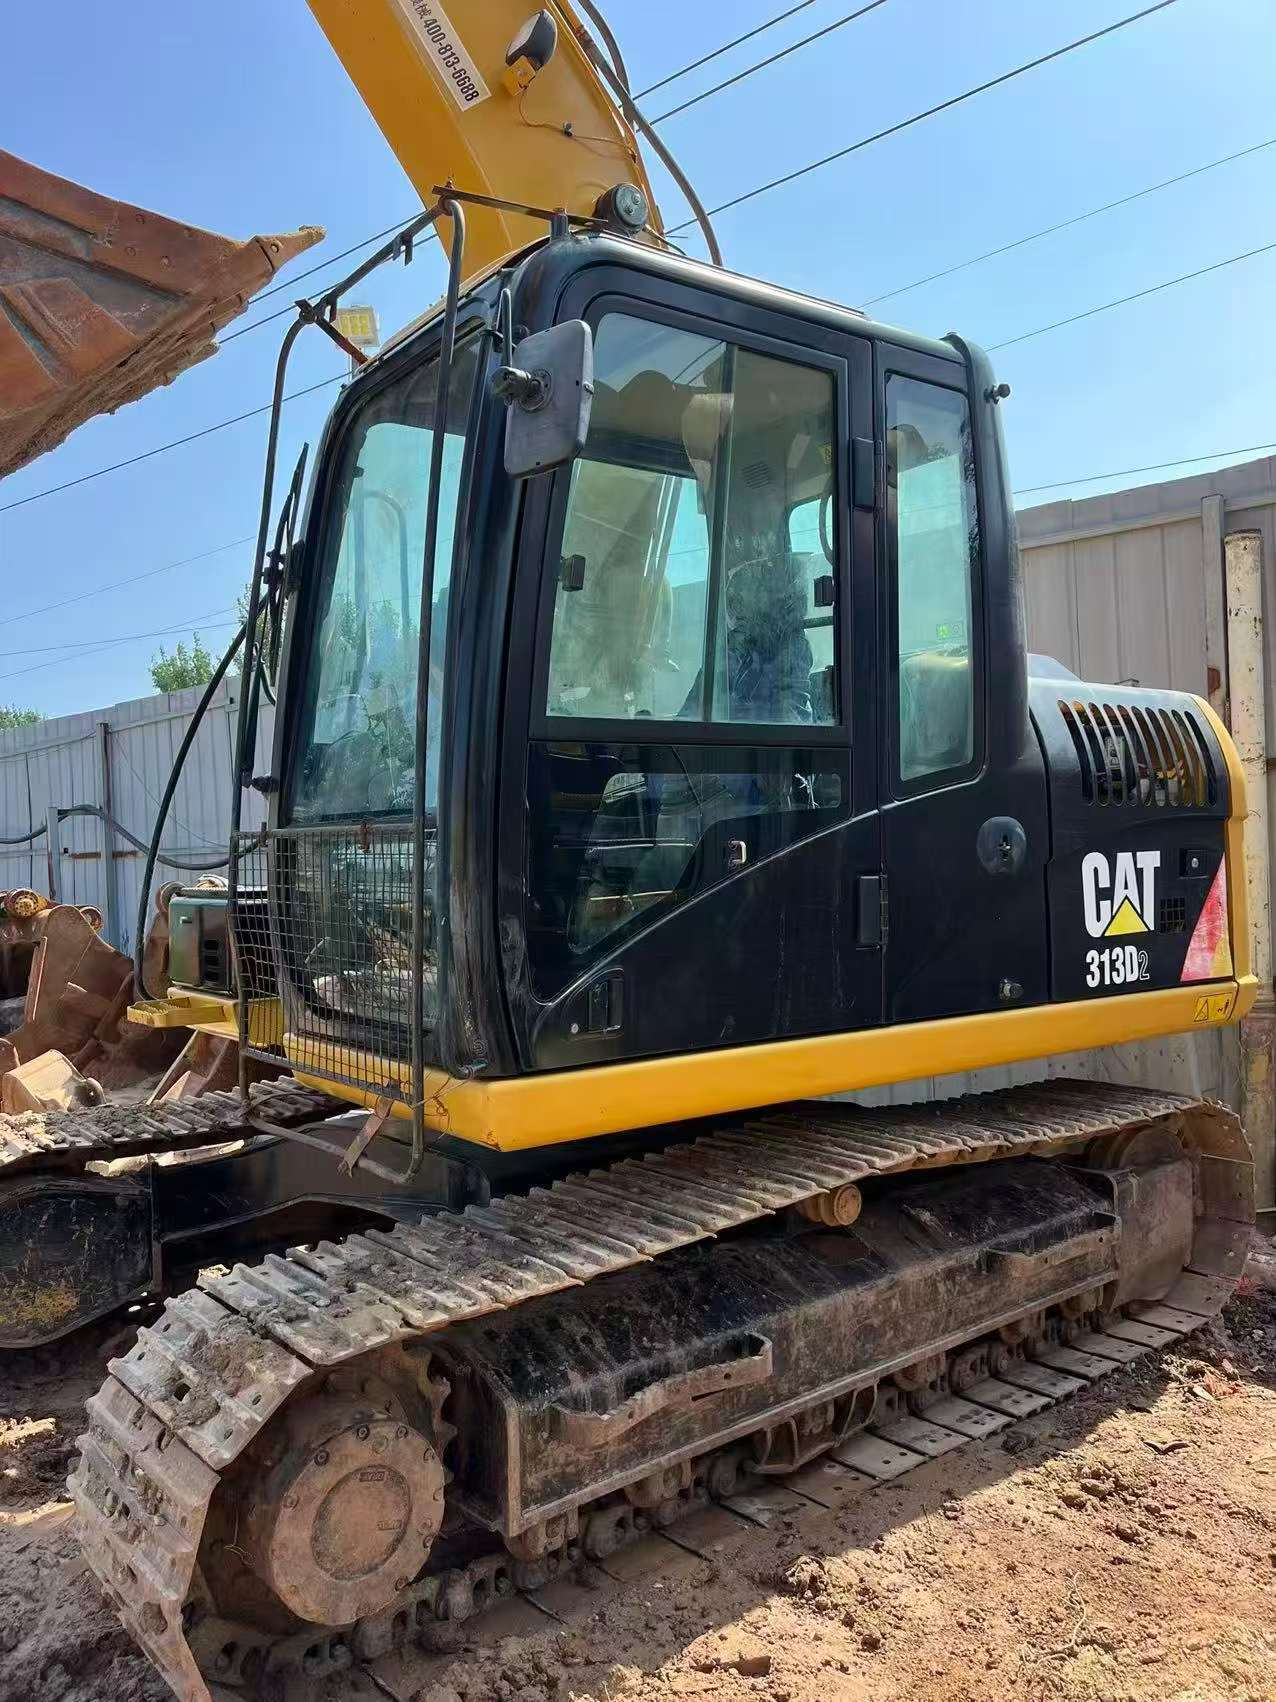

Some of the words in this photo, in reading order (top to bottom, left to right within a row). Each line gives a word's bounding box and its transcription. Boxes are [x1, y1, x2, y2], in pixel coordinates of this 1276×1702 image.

[423, 18, 480, 102] 400-813-6688
[1081, 850, 1161, 938] CAT
[1085, 945, 1150, 988] 313D2
